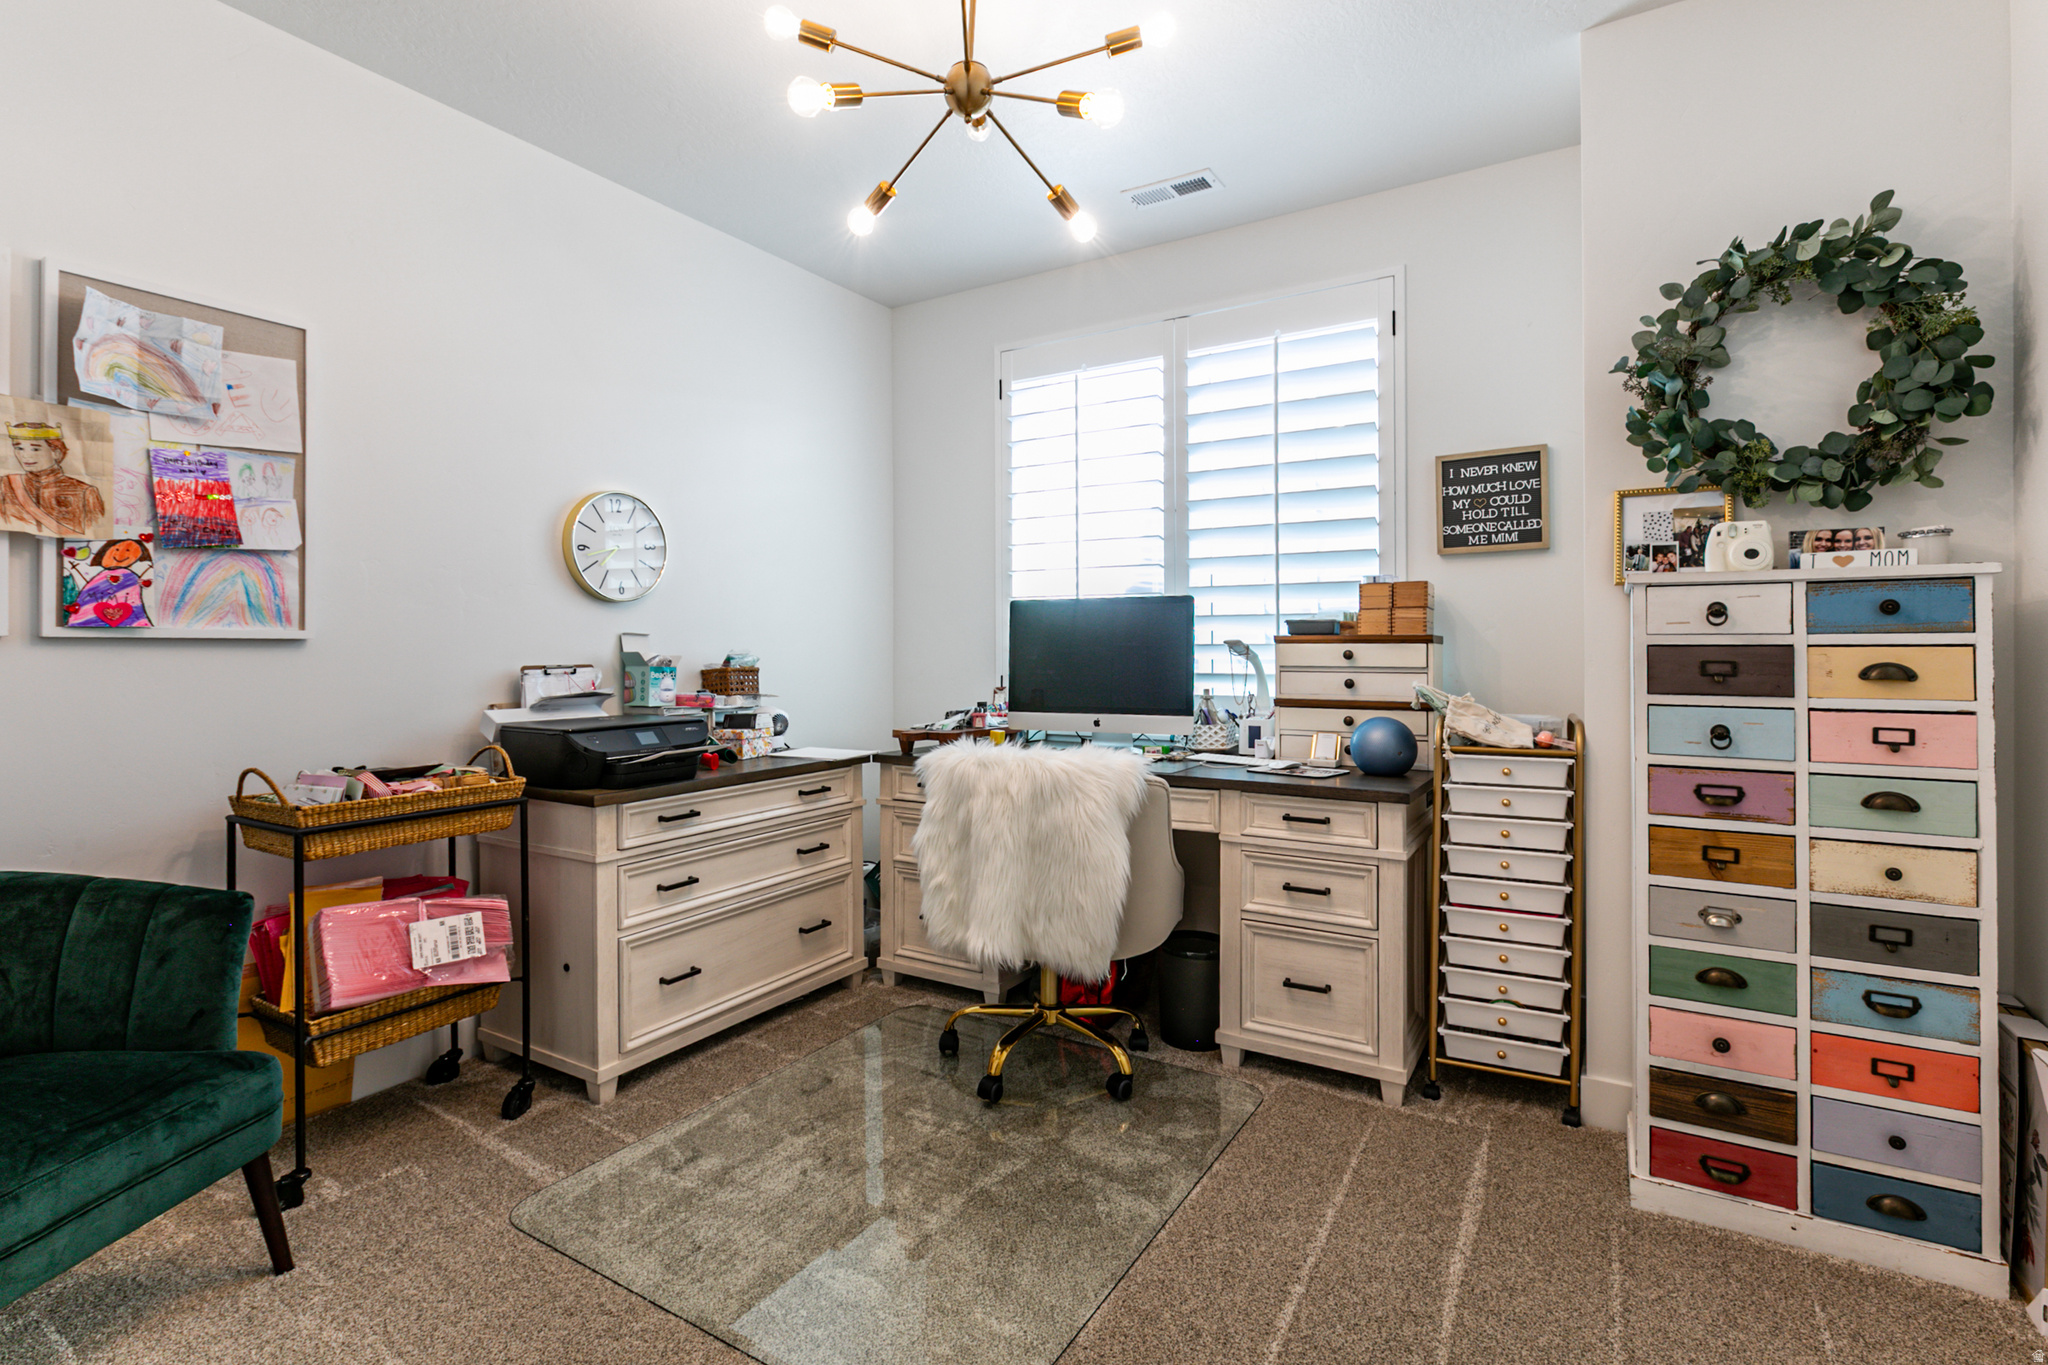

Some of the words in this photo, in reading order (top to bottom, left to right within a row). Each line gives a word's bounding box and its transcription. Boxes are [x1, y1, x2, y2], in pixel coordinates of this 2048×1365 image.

[1449, 468, 1454, 478] I
[1460, 465, 1499, 478] NEVER
[1501, 460, 1538, 473] KNEW
[1442, 485, 1469, 496] HOW
[1471, 481, 1507, 494] MUCH
[1509, 478, 1541, 490] LOVE
[609, 499, 622, 513] 12
[1452, 499, 1471, 509] MY
[1490, 493, 1532, 506] COULD
[1462, 508, 1498, 520] HOLD
[1501, 506, 1529, 517] TILL
[1443, 522, 1497, 535] SOMEONE
[1497, 519, 1543, 531] CALLED
[1468, 535, 1488, 545] ME
[1491, 532, 1519, 543] MIMI
[1870, 549, 1909, 567] MOM
